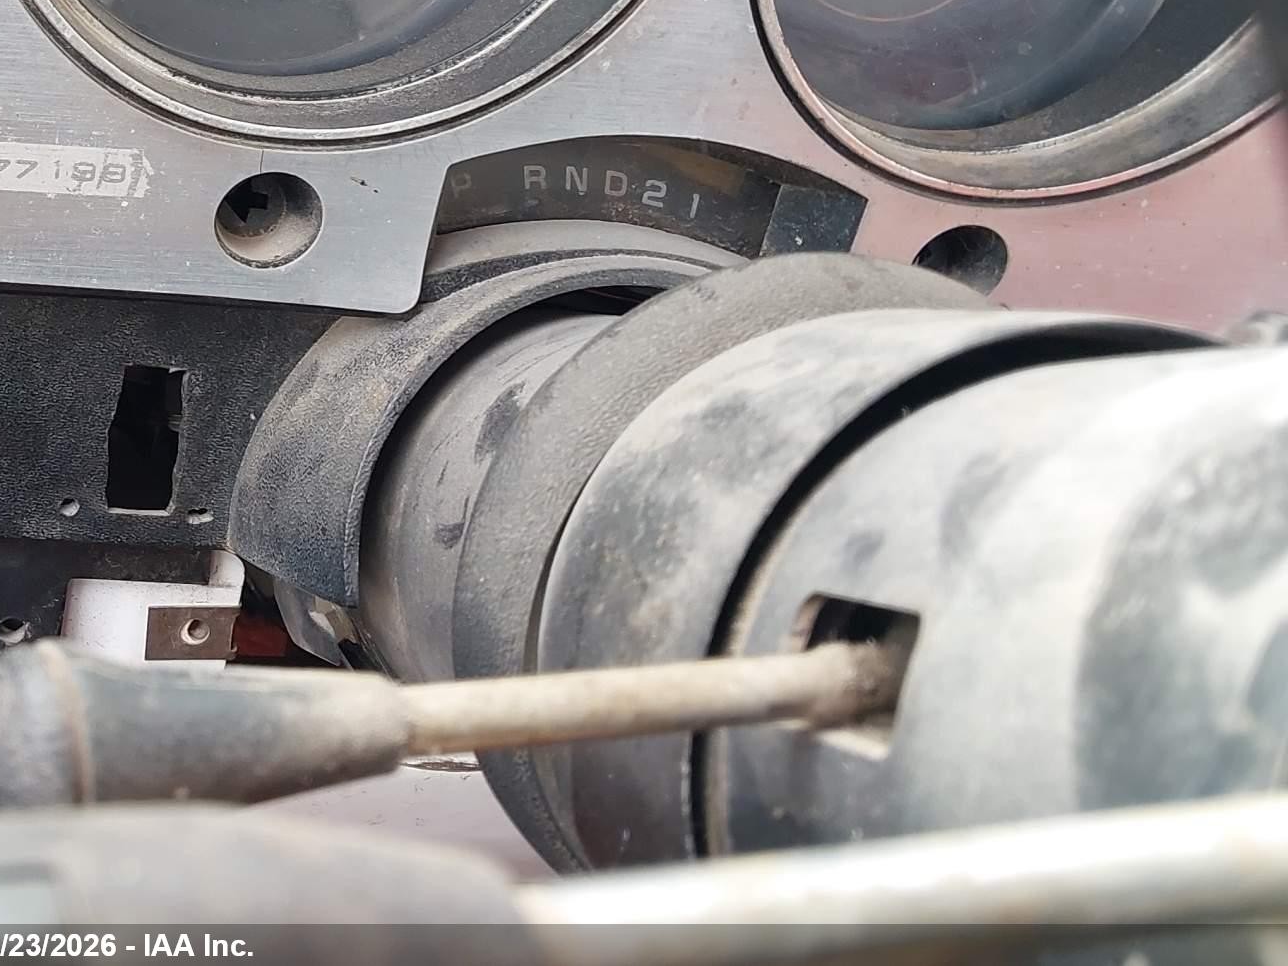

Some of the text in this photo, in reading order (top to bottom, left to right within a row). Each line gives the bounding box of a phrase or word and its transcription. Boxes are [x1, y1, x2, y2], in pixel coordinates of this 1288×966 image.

[451, 173, 473, 198] P
[523, 165, 547, 190] R
[565, 166, 588, 192] N
[605, 171, 628, 196] D
[641, 180, 668, 208] 2
